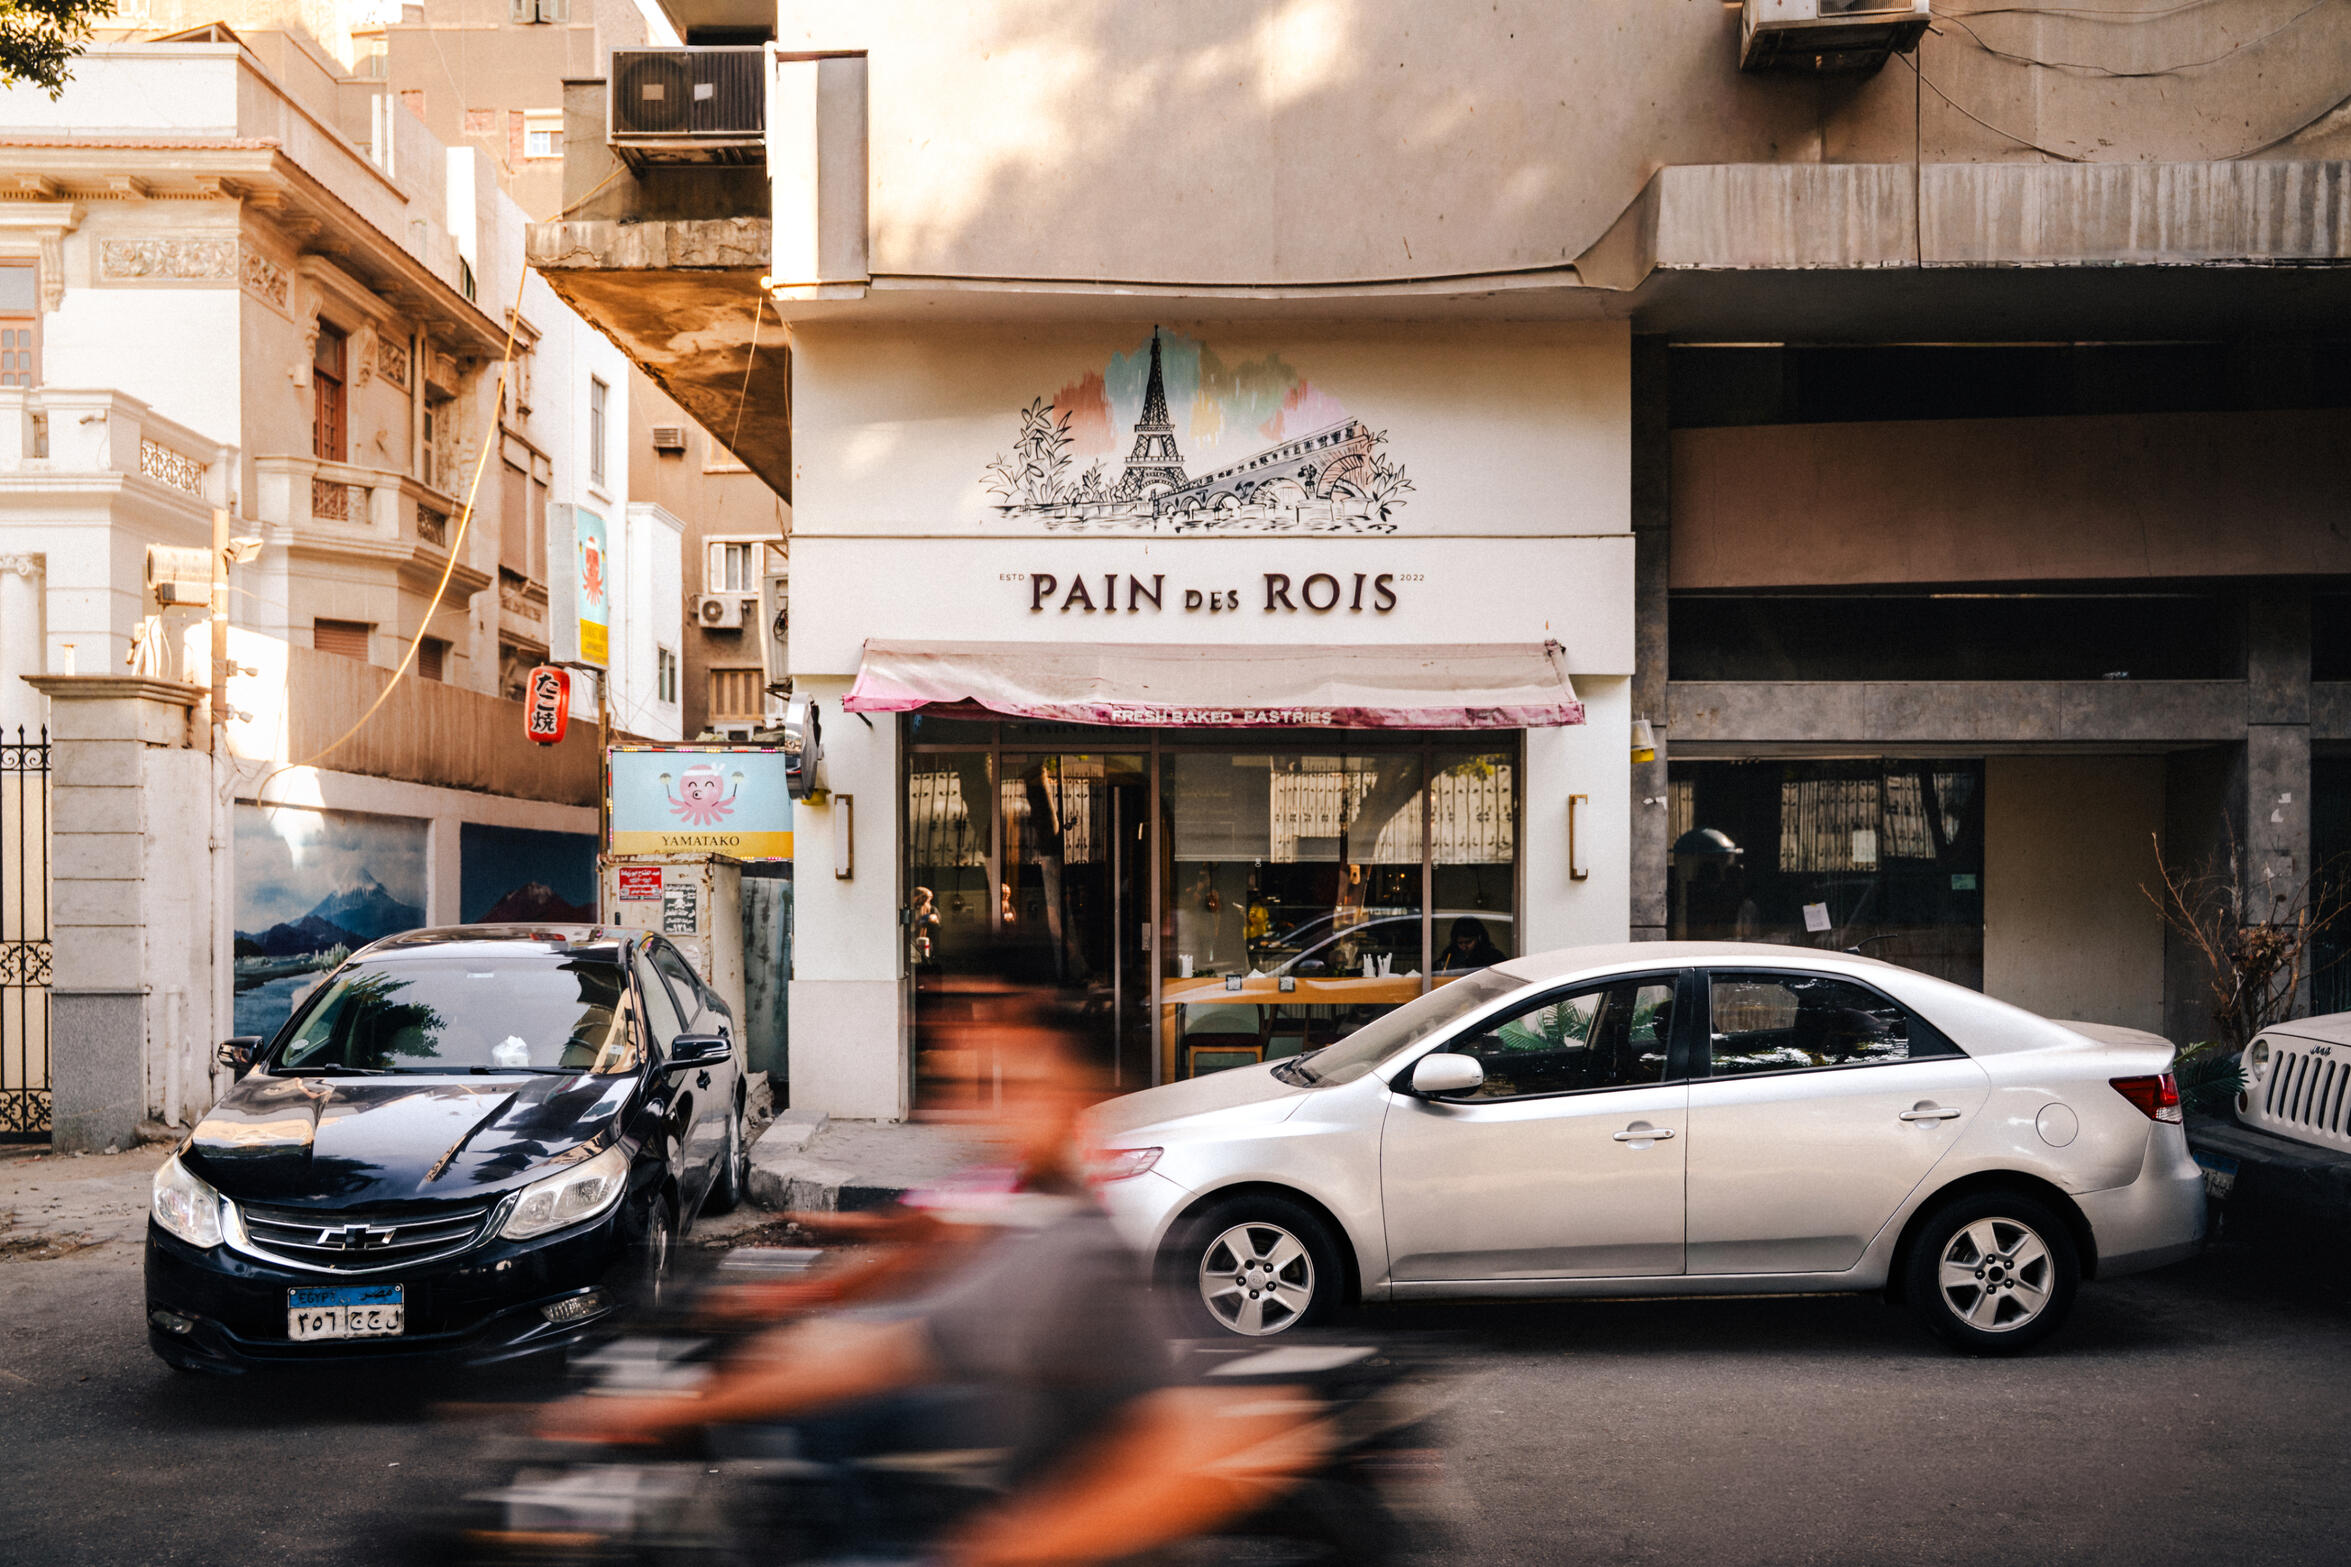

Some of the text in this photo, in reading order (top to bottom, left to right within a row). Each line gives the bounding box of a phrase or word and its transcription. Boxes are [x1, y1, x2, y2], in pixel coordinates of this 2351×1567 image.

[1000, 573, 1025, 581] ESTD
[1400, 574, 1425, 582] 2022
[1030, 573, 1397, 613] PAIN DES ROIS
[531, 673, 559, 733] たこ焼
[1112, 710, 1332, 725] FRESH BAKED PASTRIES
[662, 836, 740, 846] YAMATAKO
